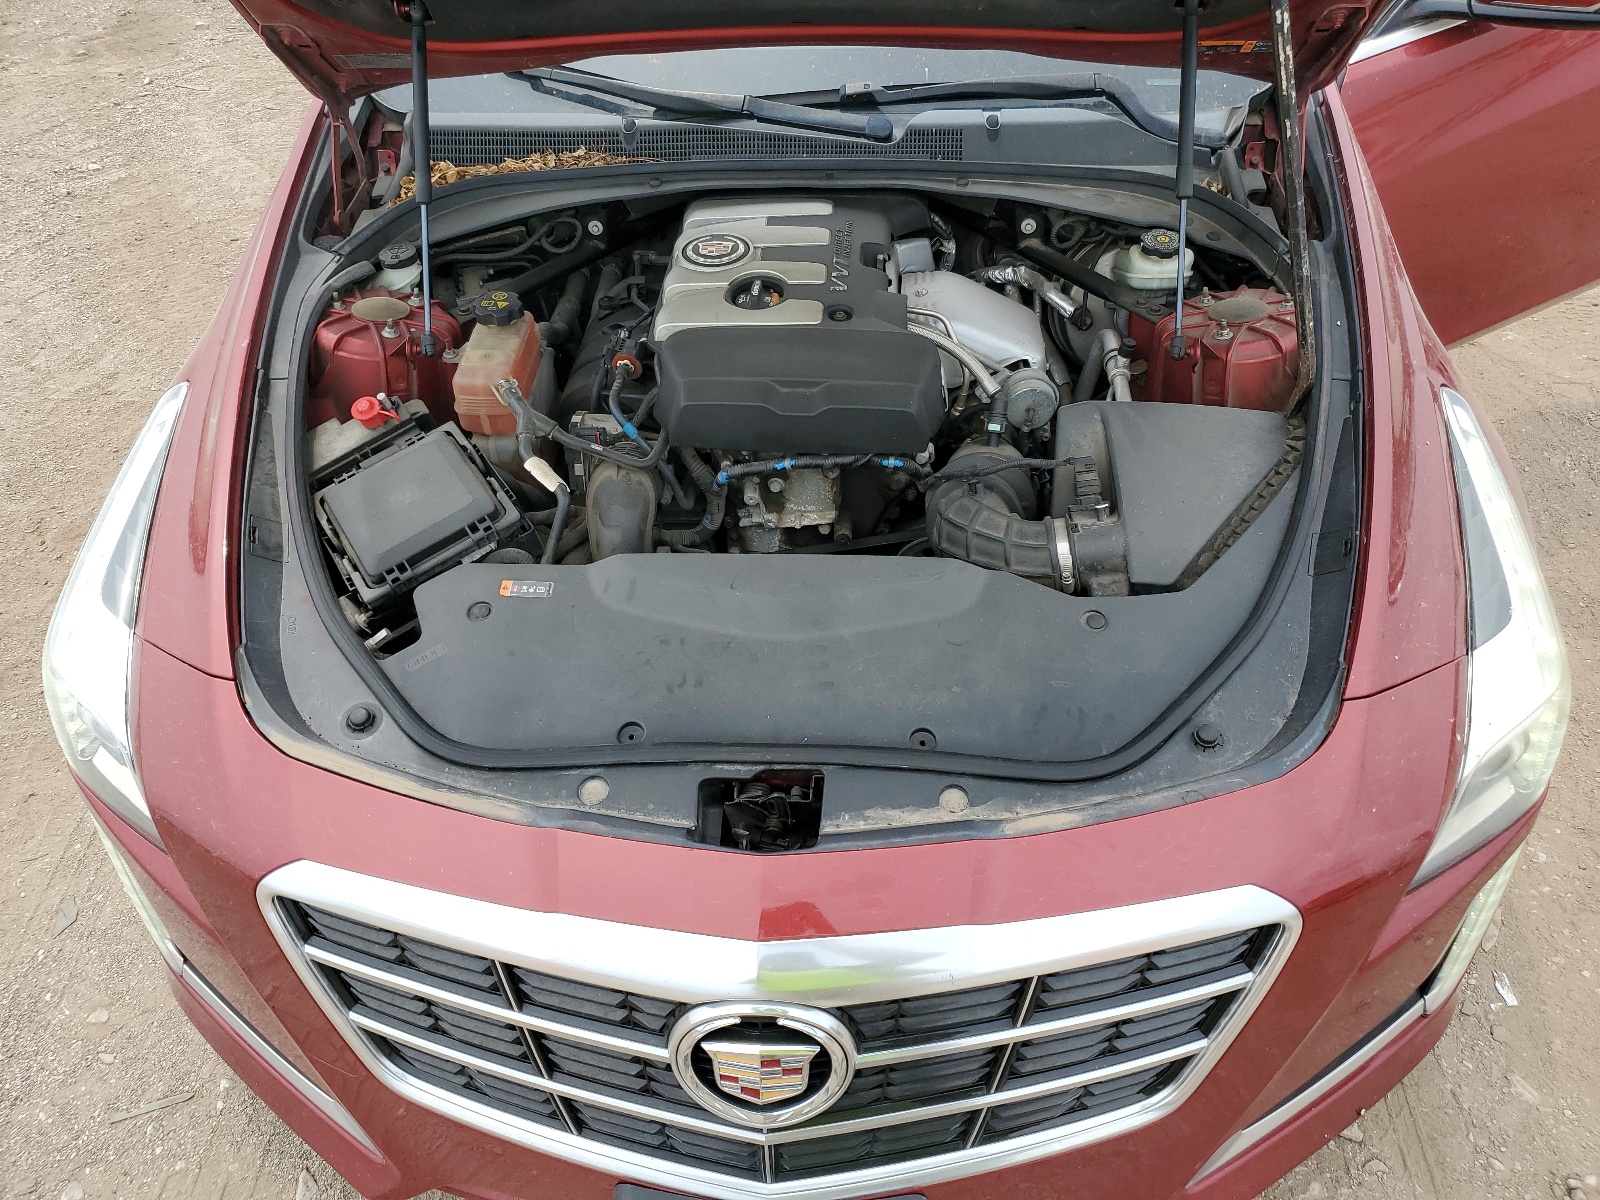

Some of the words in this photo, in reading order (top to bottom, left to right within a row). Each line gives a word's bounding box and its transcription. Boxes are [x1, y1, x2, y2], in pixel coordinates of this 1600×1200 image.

[833, 228, 843, 255] DIRECT
[843, 220, 853, 257] INJECTION
[829, 253, 850, 291] VVT
